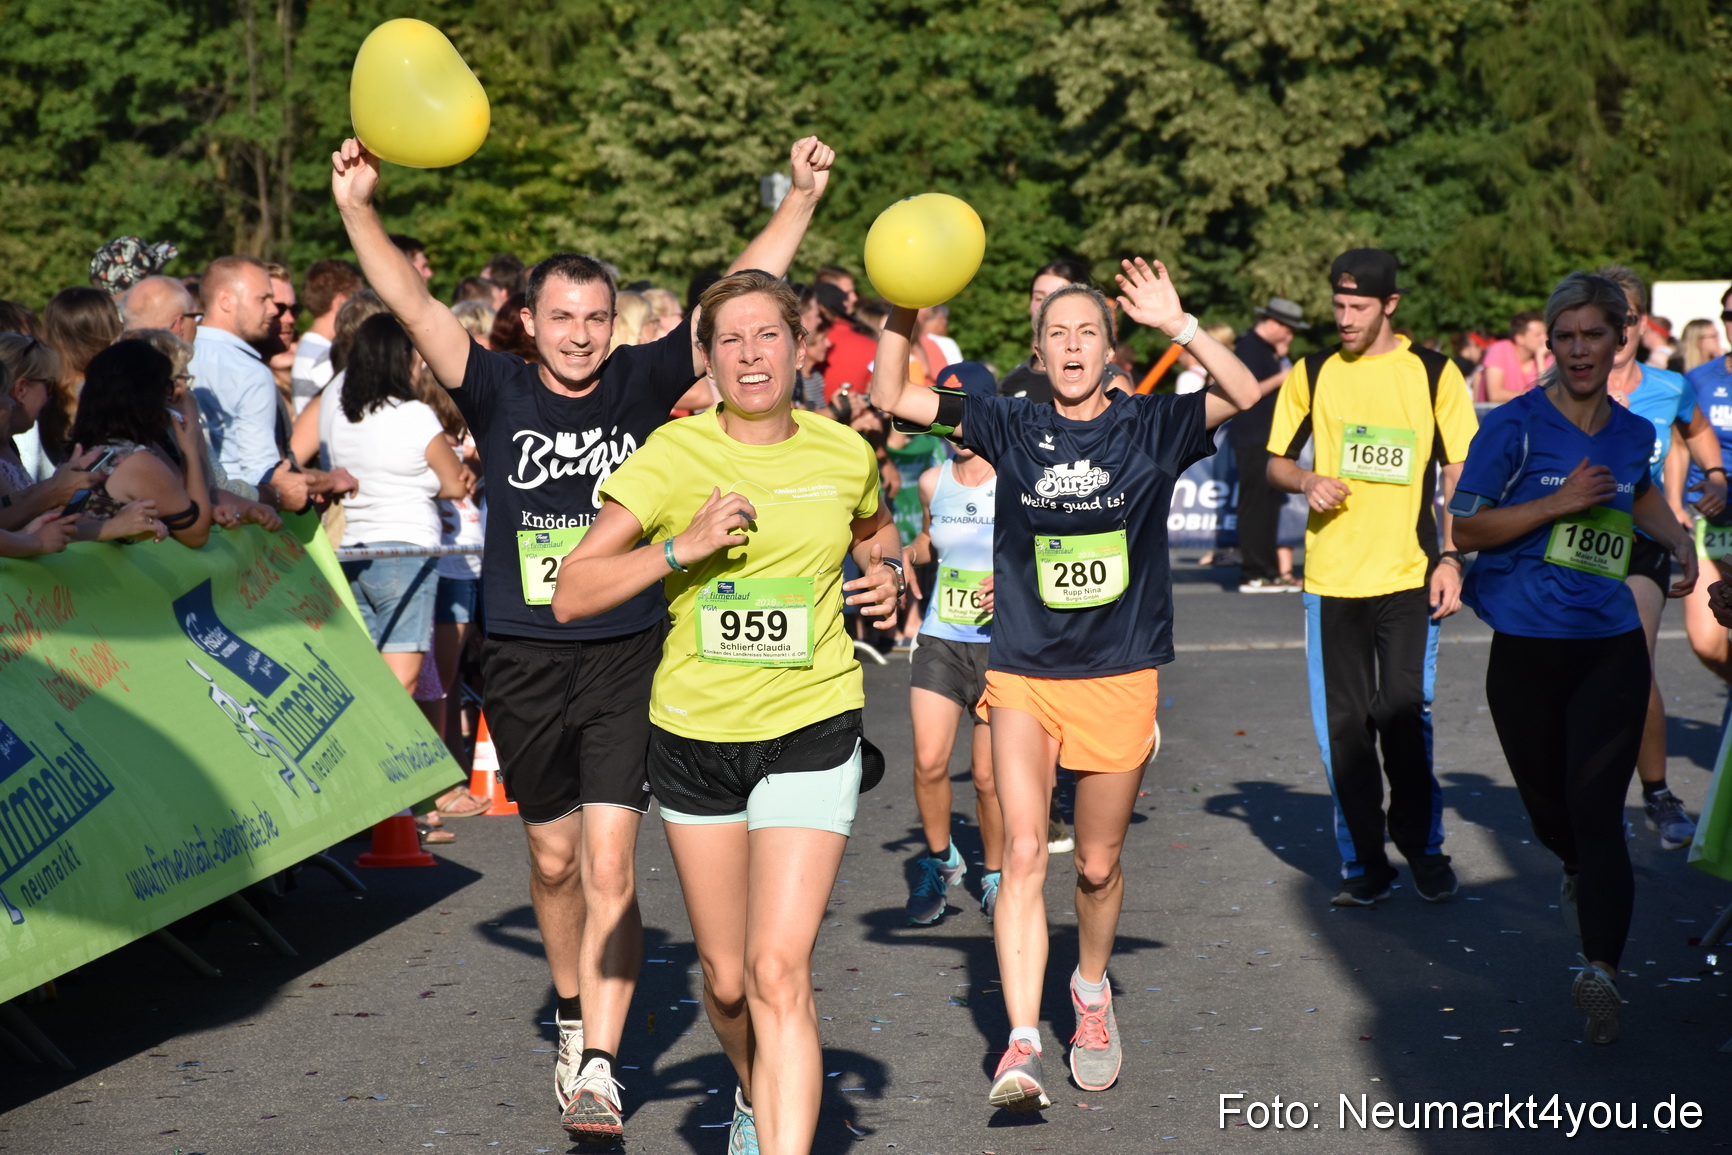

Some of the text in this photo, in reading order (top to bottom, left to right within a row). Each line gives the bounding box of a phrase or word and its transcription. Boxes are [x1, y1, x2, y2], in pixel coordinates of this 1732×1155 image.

[508, 425, 637, 509] Burgis
[1350, 443, 1404, 467] 1688
[1035, 459, 1111, 498] Burgis
[1021, 493, 1125, 513] Weil's guad is!
[522, 511, 599, 530] Knödelli
[1565, 524, 1625, 560] 1800
[1575, 551, 1593, 561] Maier
[1053, 560, 1107, 588] 280
[710, 592, 751, 600] firmenlauf
[945, 588, 985, 609] 176
[1063, 589, 1082, 597] Rupp
[720, 610, 788, 641] 959
[720, 642, 791, 651] Schlierf Claudia
[311, 734, 347, 781] neumarkt
[19, 839, 82, 909] neumarkt
